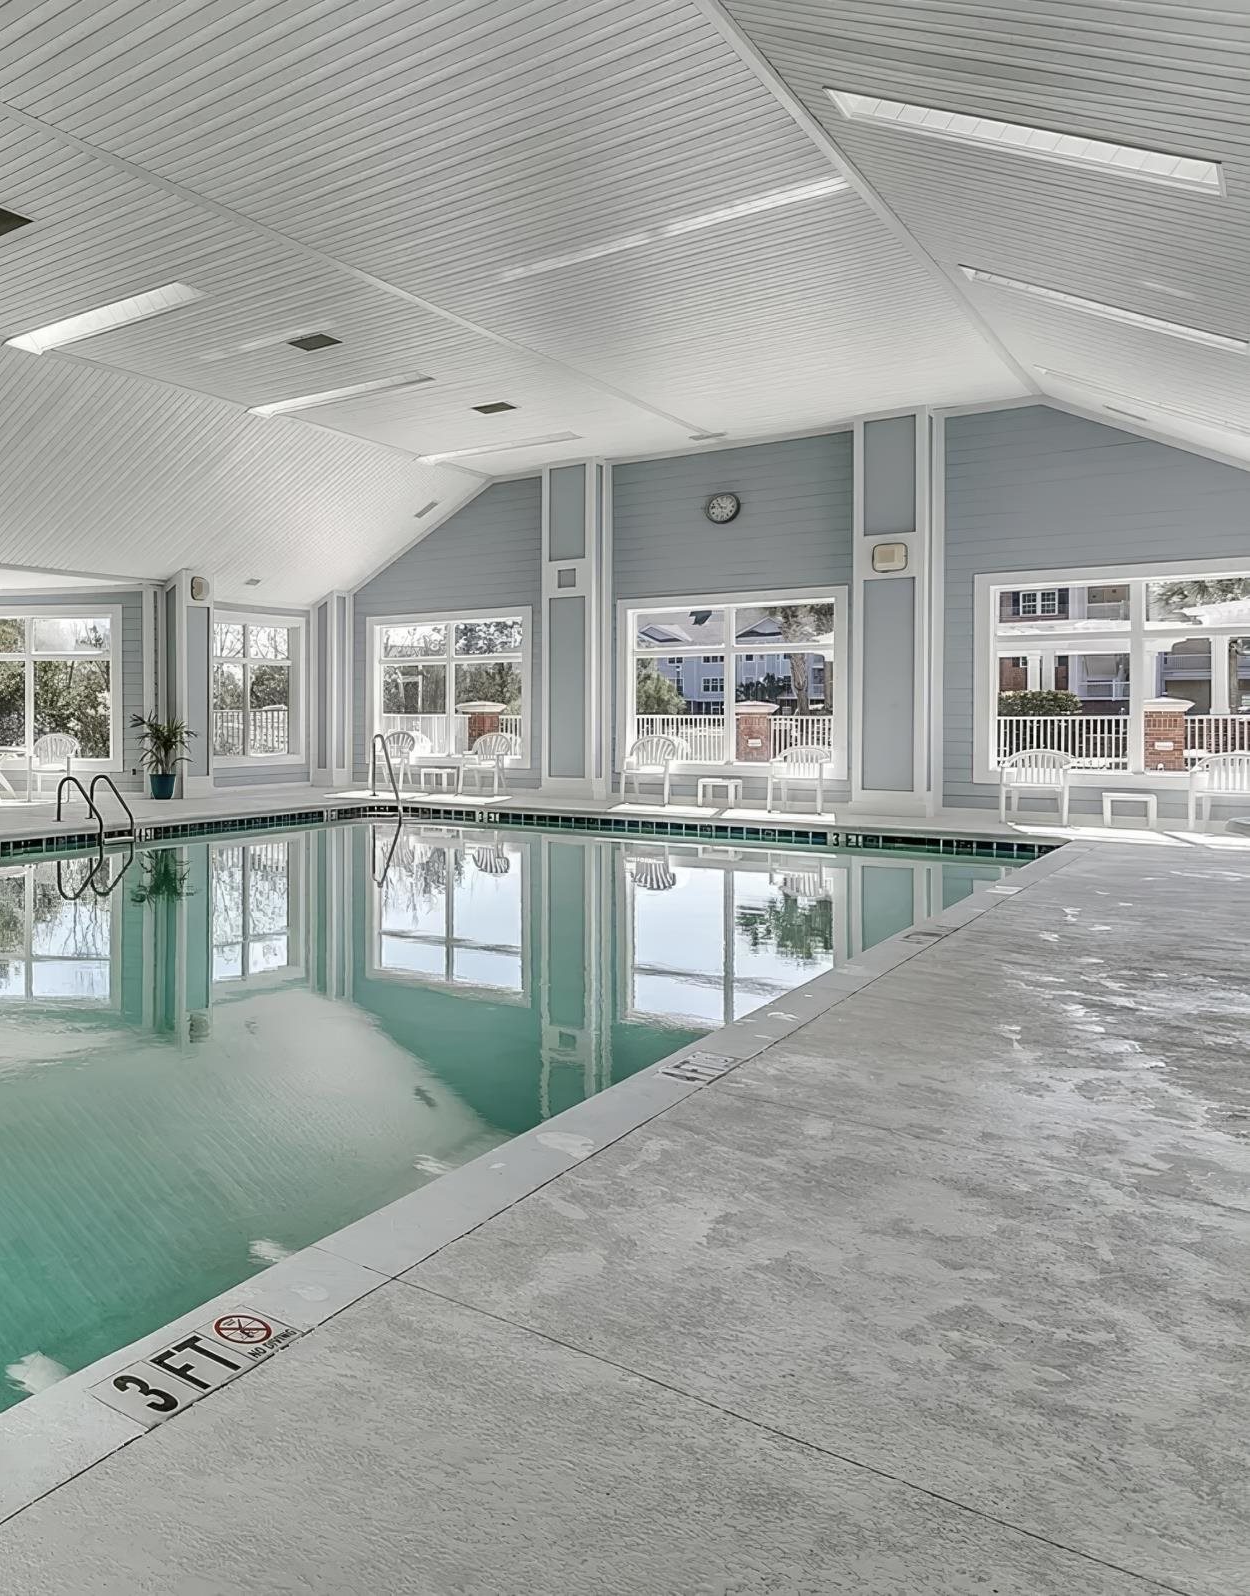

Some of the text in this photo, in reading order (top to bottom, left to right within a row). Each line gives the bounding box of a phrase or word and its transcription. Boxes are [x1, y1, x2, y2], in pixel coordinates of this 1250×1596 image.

[247, 1329, 298, 1359] NO DIVING
[112, 1335, 242, 1413] 3 FT
